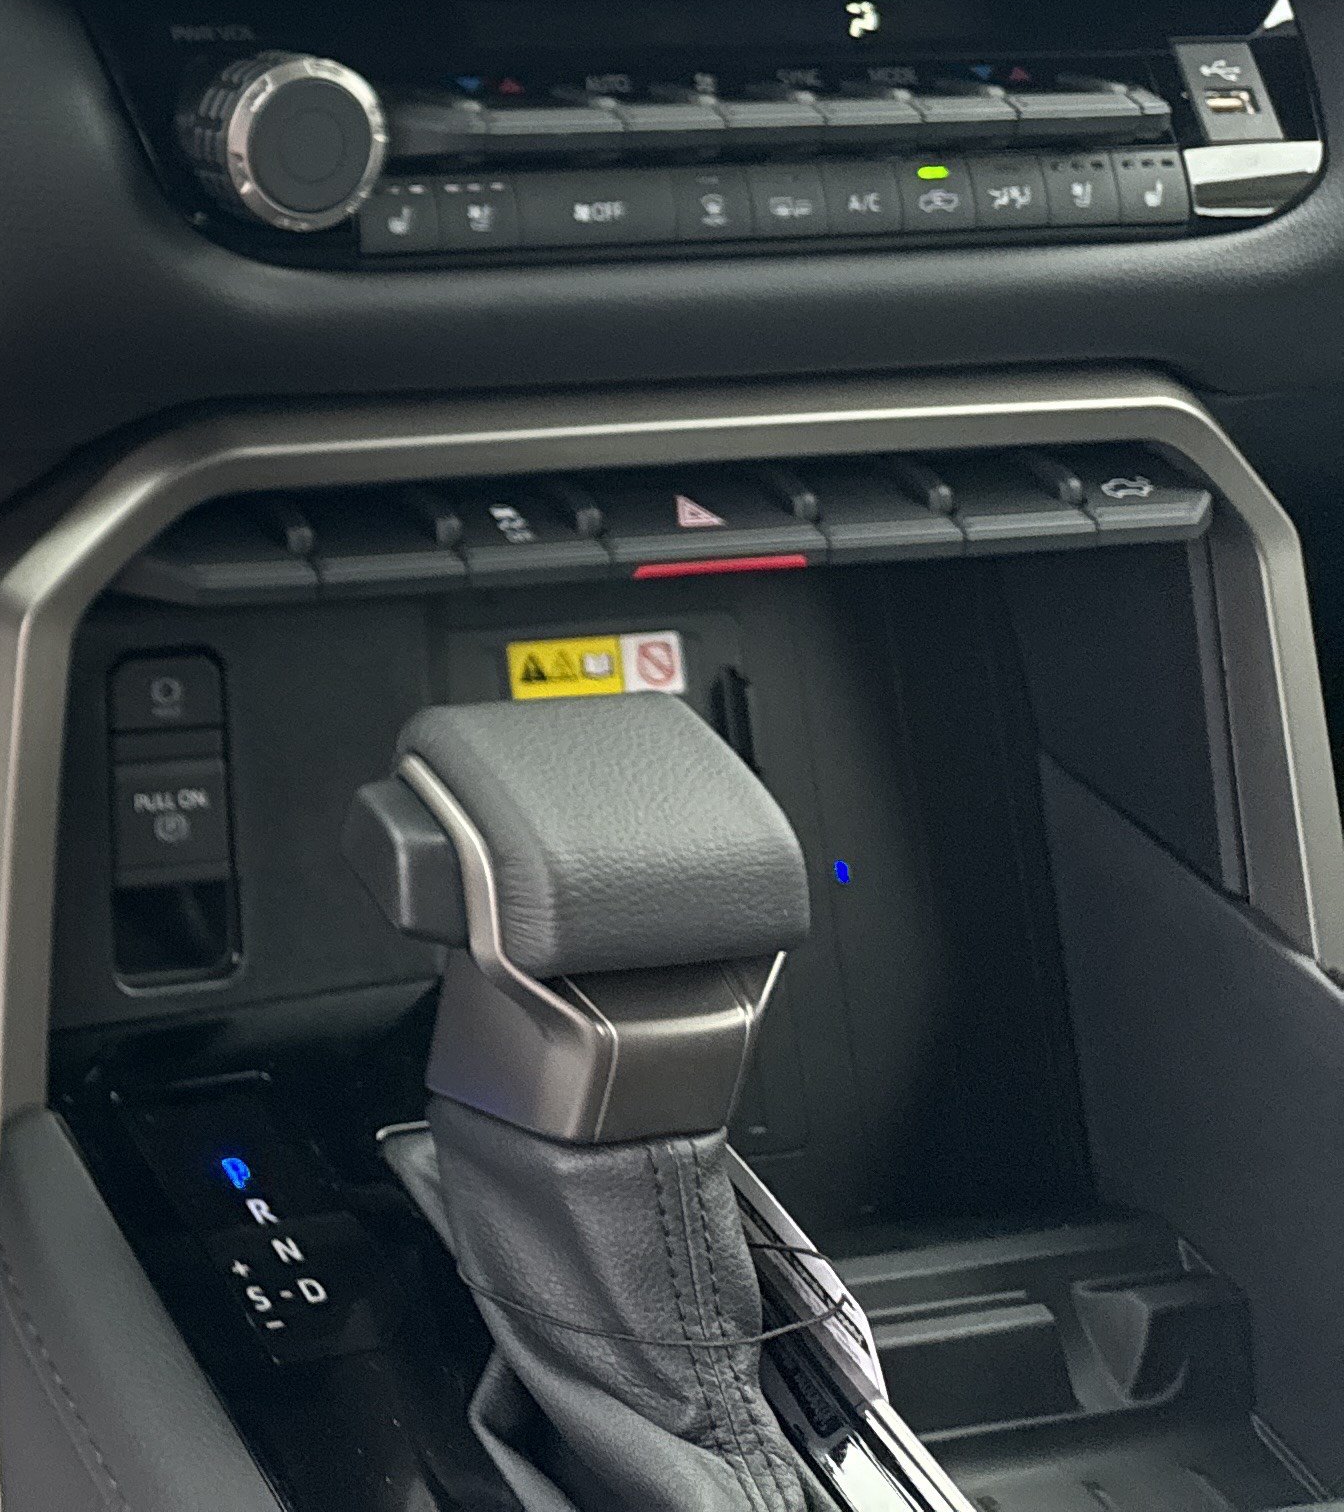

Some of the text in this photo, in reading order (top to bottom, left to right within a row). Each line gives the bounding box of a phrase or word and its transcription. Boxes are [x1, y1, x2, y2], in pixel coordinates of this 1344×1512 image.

[847, 192, 881, 213] A/C
[245, 1198, 280, 1225] R
[270, 1237, 305, 1264] N
[245, 1285, 273, 1312] S
[297, 1277, 328, 1304] D
